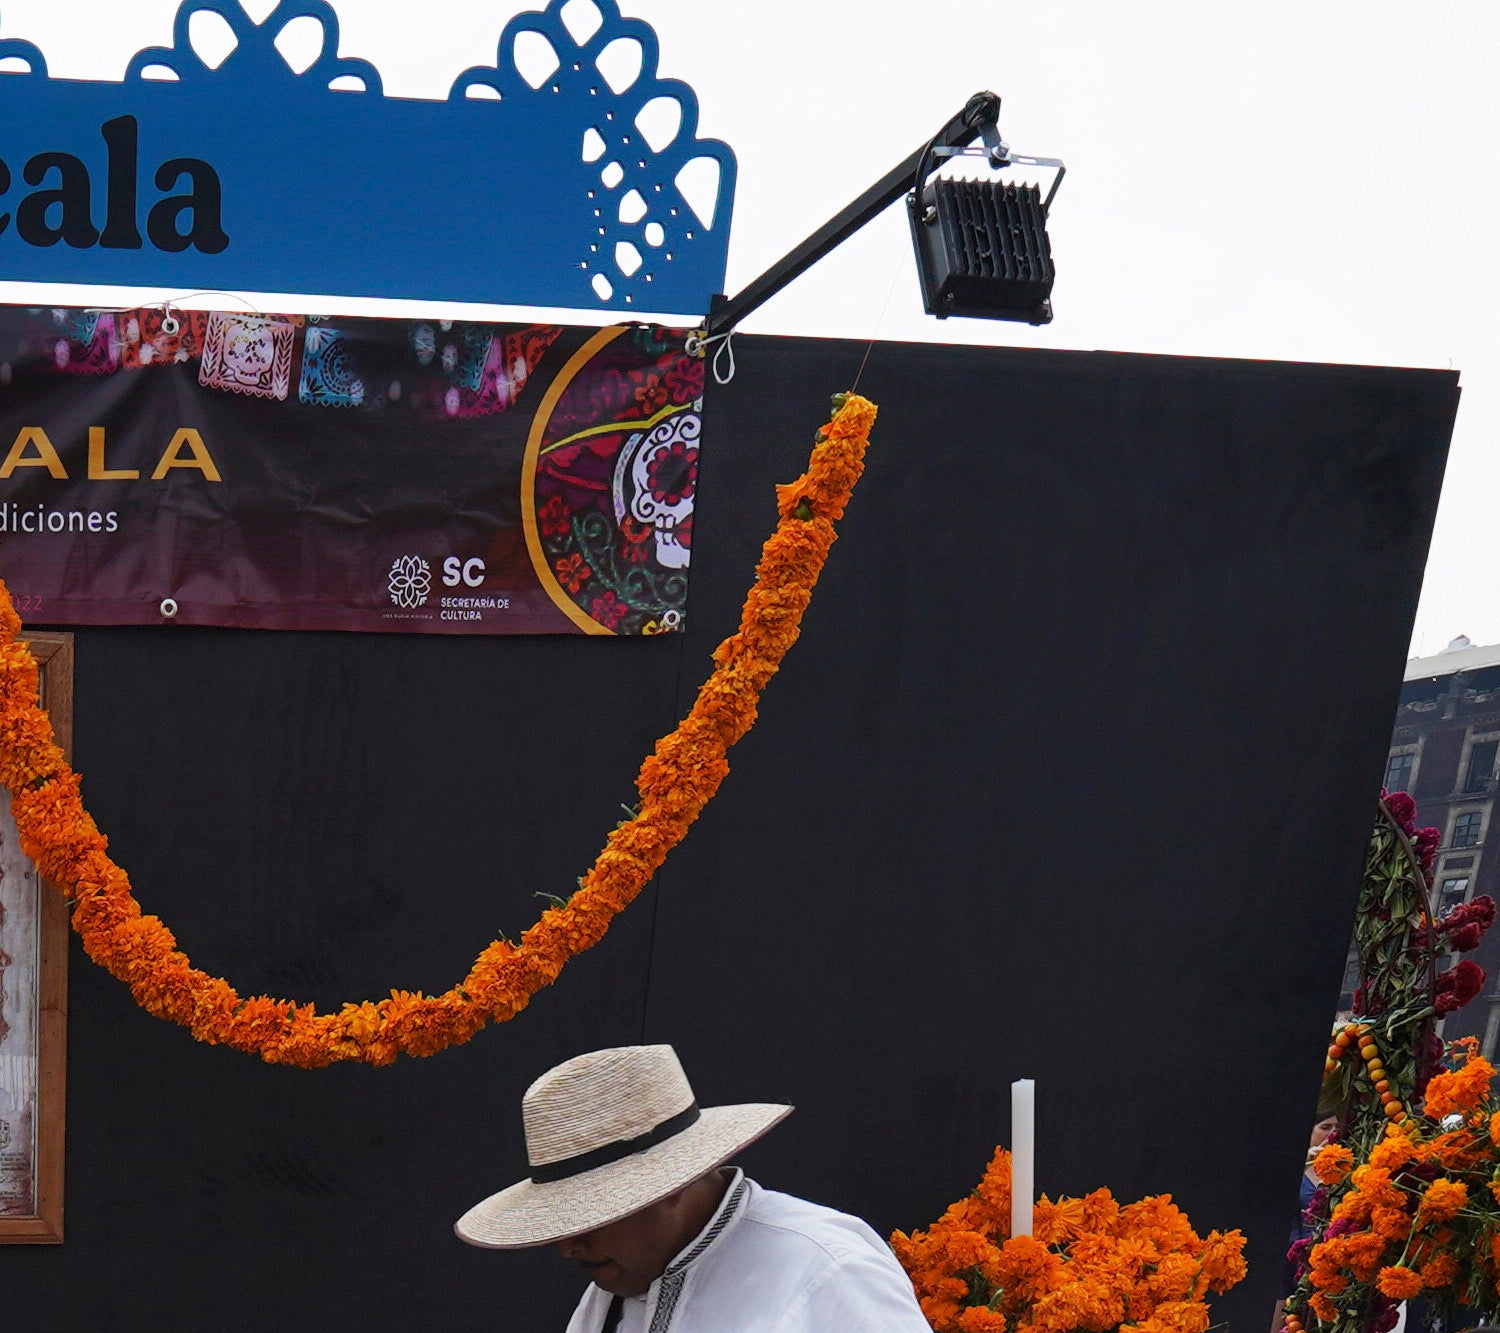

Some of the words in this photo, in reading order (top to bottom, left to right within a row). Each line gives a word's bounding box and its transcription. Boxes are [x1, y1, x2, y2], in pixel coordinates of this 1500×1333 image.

[442, 556, 486, 588] SC
[440, 596, 495, 609] SECRETARÍA
[497, 599, 510, 609] DE
[440, 610, 482, 621] CULTURA
